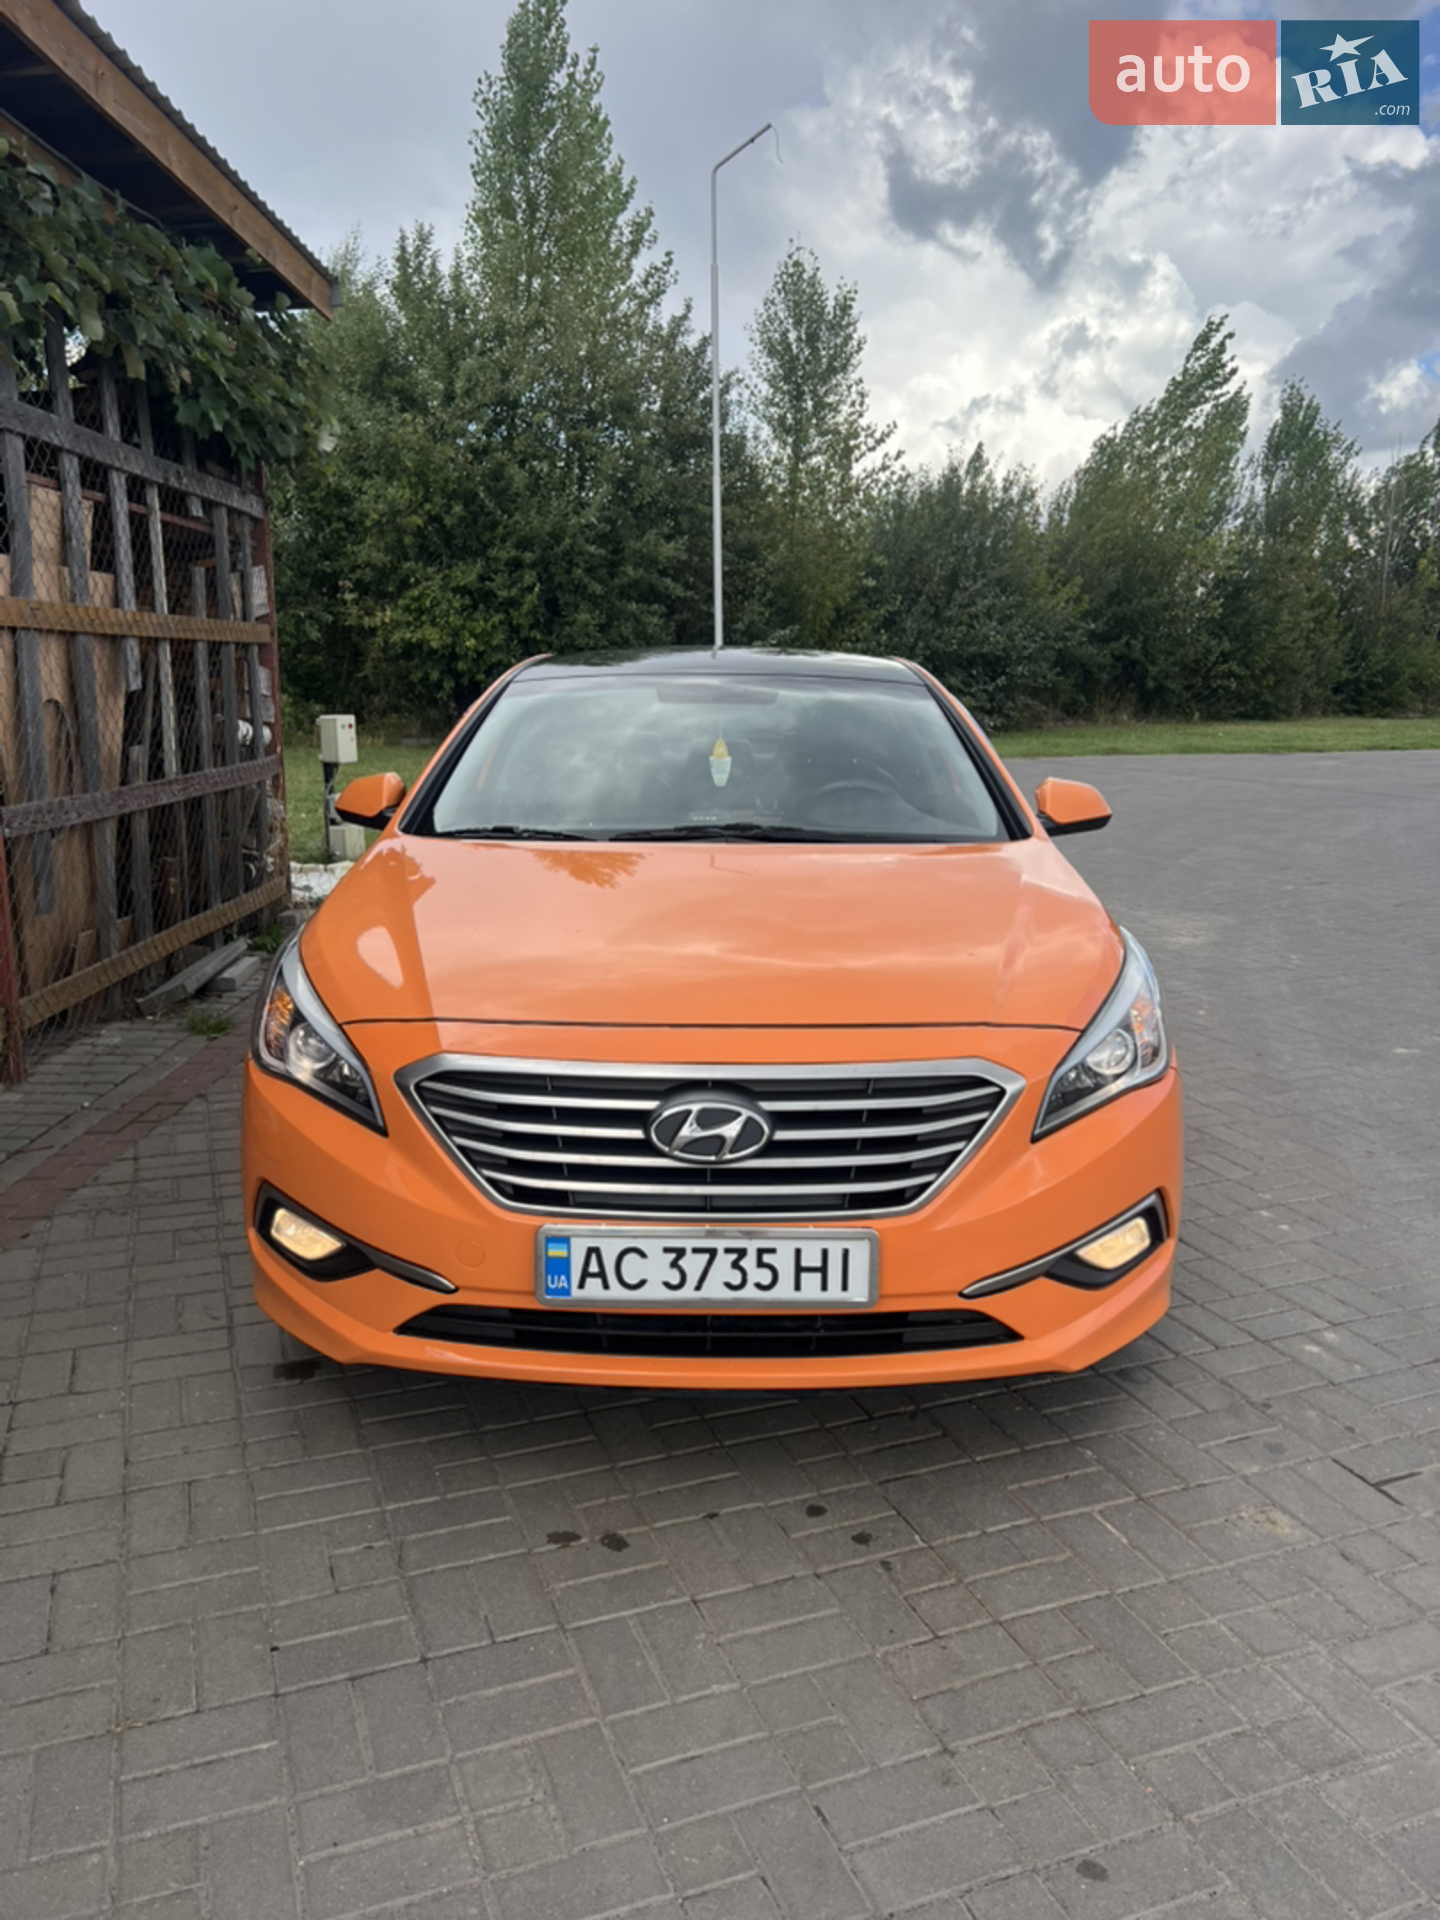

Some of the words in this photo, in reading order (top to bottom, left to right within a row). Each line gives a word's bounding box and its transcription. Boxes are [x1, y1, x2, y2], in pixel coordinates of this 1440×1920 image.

[547, 1274, 569, 1290] UA
[577, 1246, 649, 1291] AC
[661, 1247, 780, 1291] 3735
[794, 1248, 850, 1292] HI
